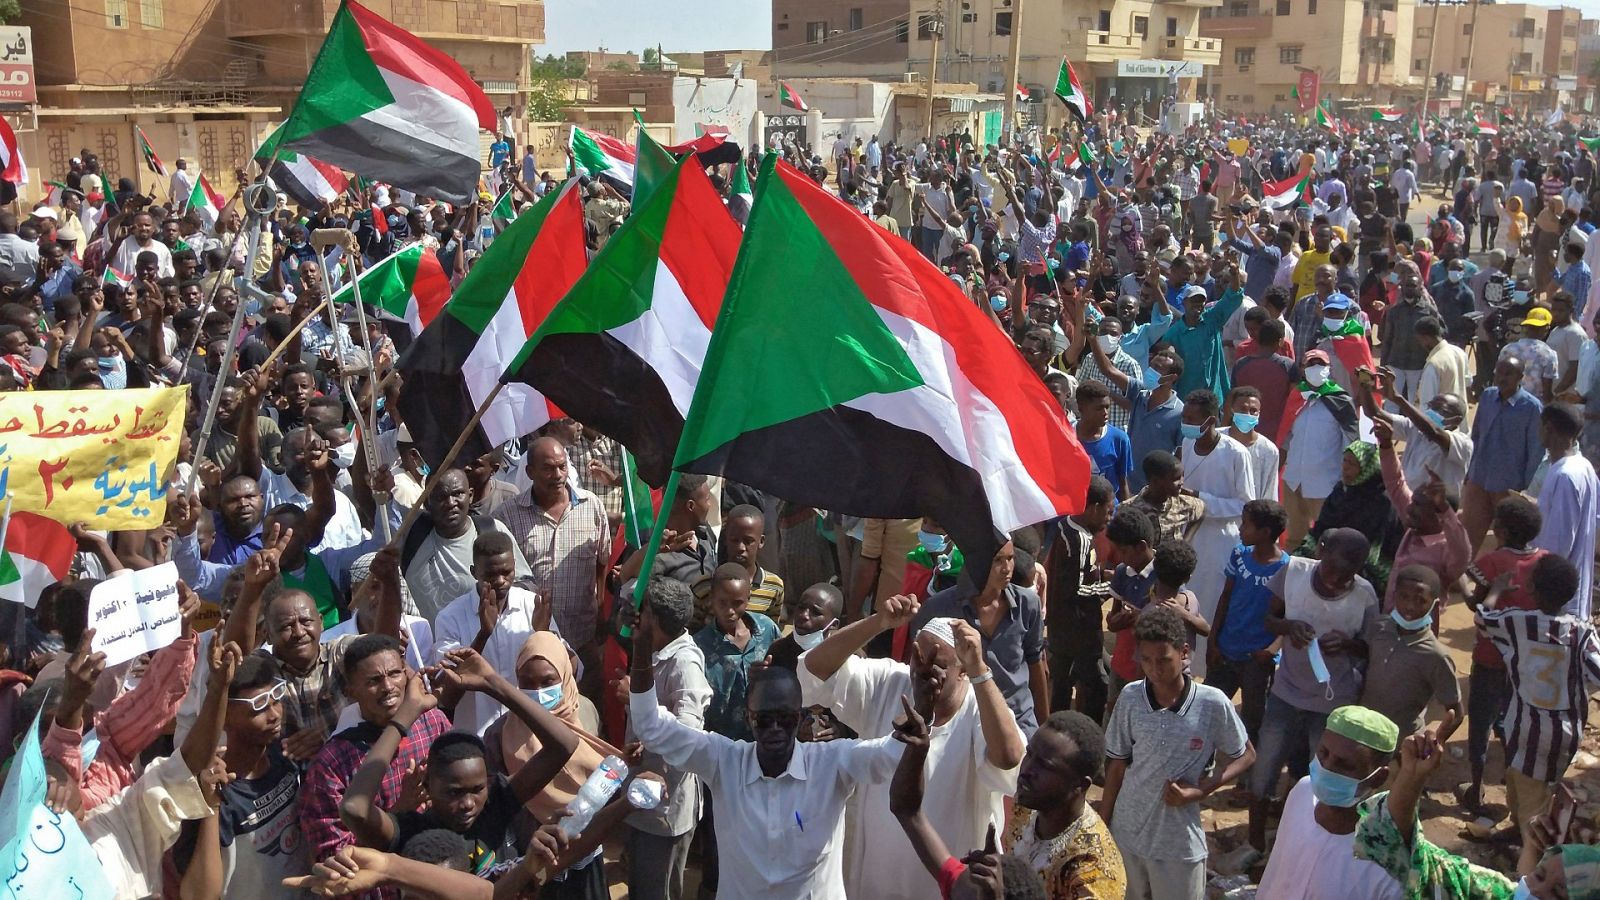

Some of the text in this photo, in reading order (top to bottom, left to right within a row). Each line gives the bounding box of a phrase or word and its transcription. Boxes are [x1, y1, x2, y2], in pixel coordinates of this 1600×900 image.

[28, 401, 121, 444] يسقط
[38, 456, 74, 510] ٣٠
[93, 455, 171, 516] مليونية
[1236, 557, 1252, 579] NEW
[134, 583, 176, 605] مليونية
[1529, 647, 1565, 708] 3
